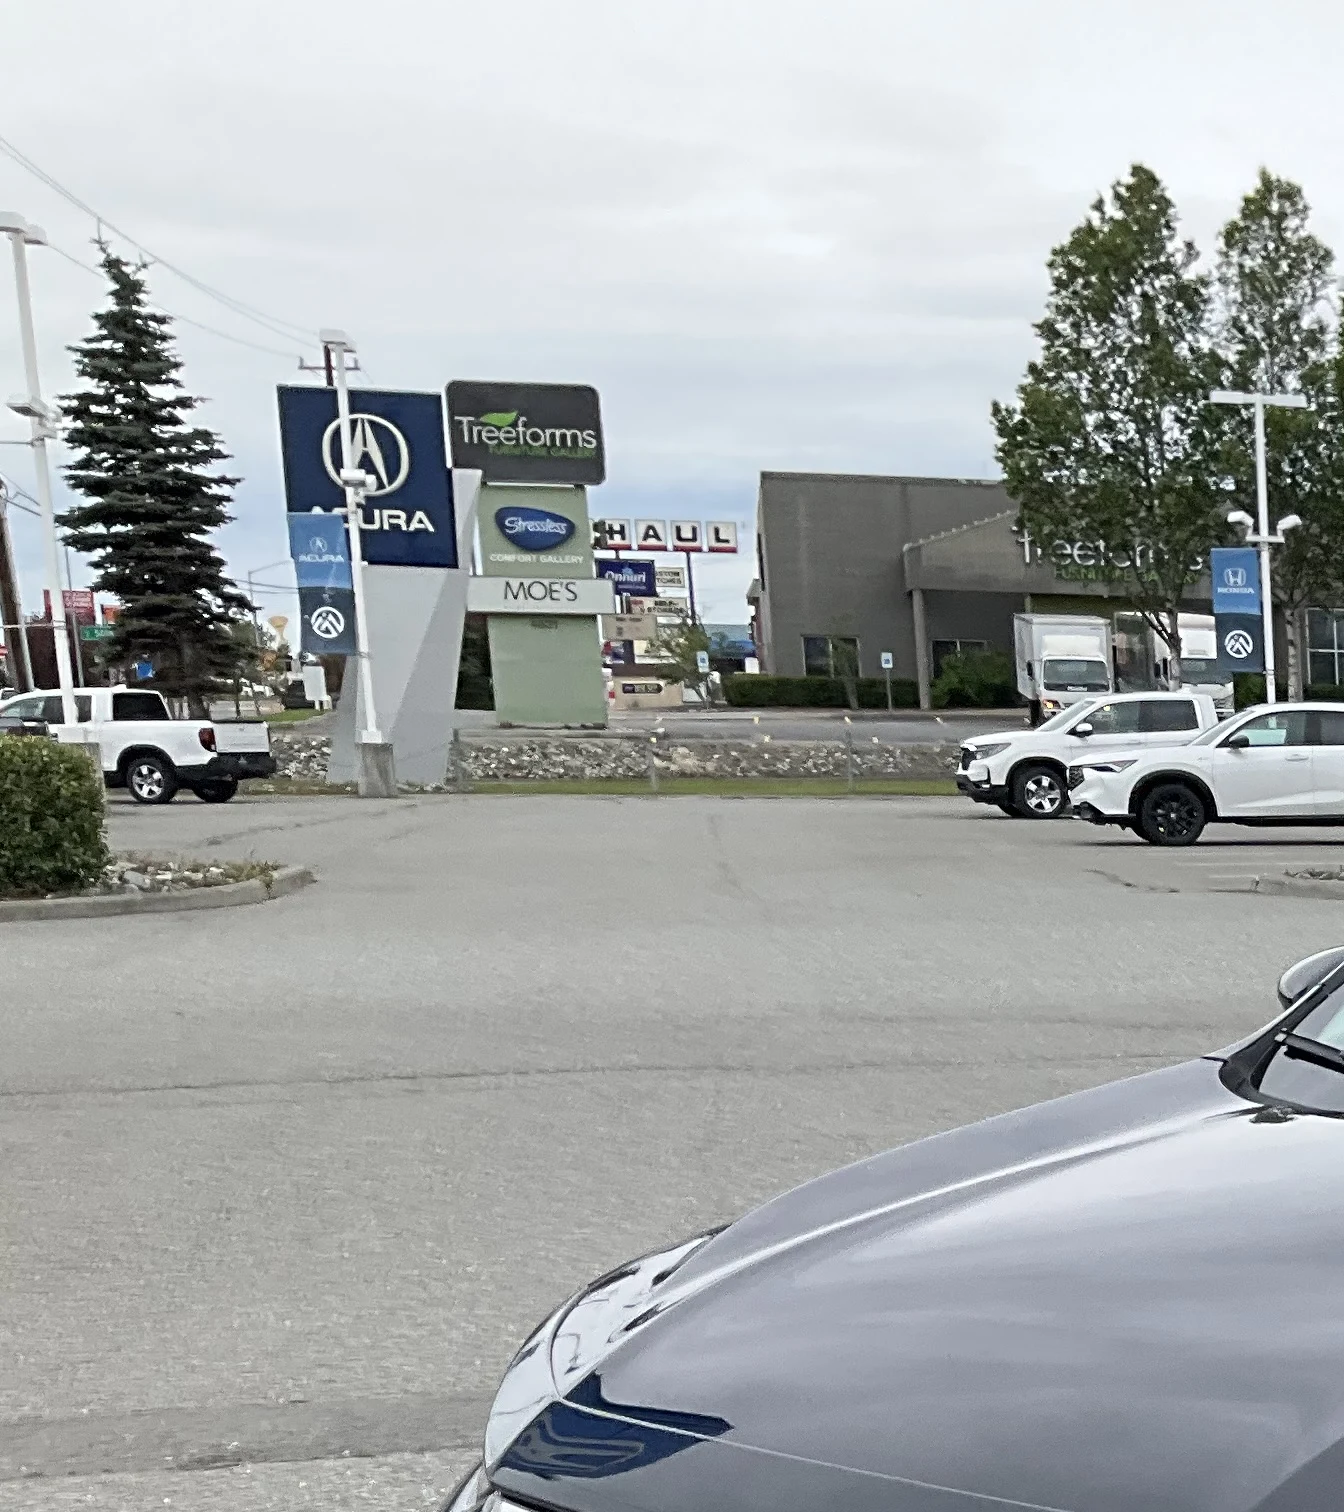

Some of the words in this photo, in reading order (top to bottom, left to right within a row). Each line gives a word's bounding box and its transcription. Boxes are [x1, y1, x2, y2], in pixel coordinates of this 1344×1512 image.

[454, 416, 597, 448] Treeforms
[504, 516, 567, 534] Stressless
[298, 554, 345, 563] ACURA
[490, 553, 537, 563] COMFORT
[540, 554, 584, 564] GALLERY
[504, 581, 578, 602] MOE'S
